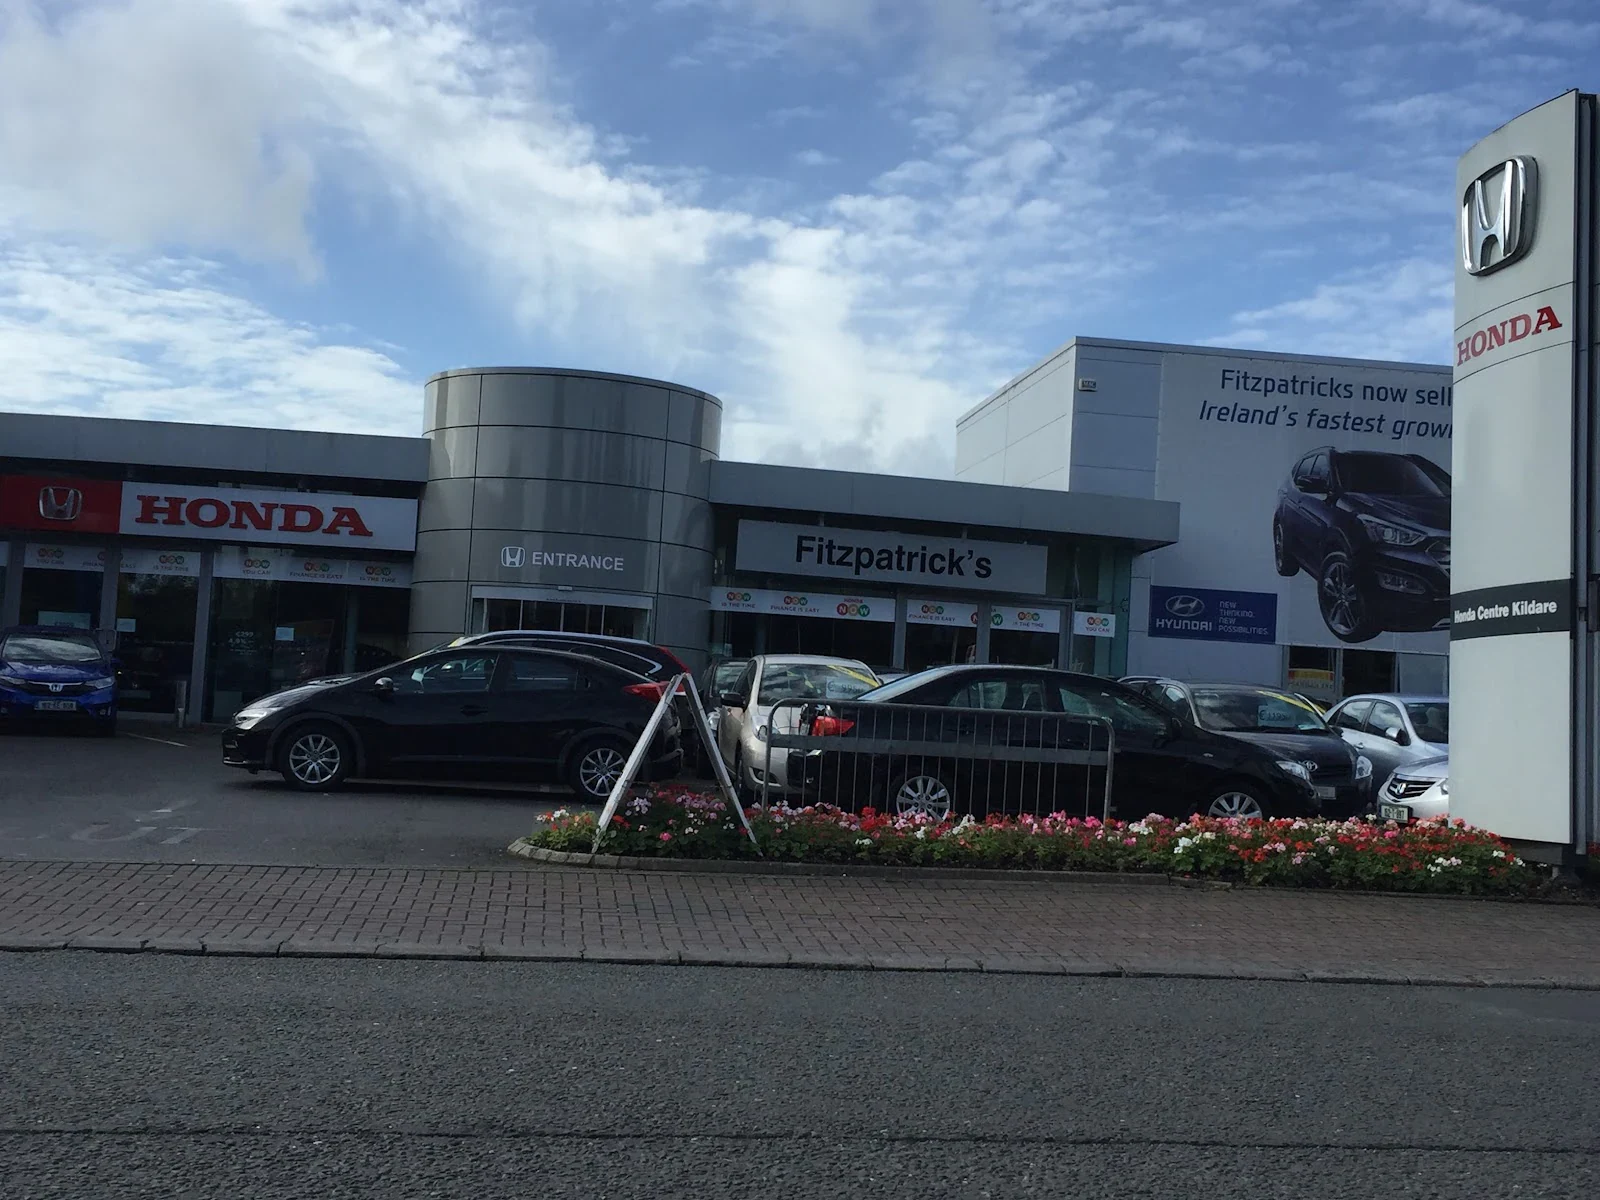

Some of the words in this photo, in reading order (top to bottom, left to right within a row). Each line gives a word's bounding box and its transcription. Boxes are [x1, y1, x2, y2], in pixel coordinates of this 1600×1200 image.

[1457, 305, 1563, 367] HONDA
[1220, 368, 1354, 400] Fitzpatricks
[1362, 384, 1409, 404] now
[1415, 386, 1452, 407] sell
[1199, 400, 1297, 427] Ireland's
[1306, 408, 1384, 434] fastest
[135, 494, 373, 537] HONDA
[531, 551, 624, 571] ENTRANCE
[795, 534, 992, 578] Fitzpatrick's
[244, 558, 271, 568] NOW
[304, 561, 330, 571] NOW
[365, 565, 391, 576] NOW
[727, 591, 752, 601] NOW
[783, 595, 809, 605] NOW
[836, 602, 871, 617] NOW
[921, 604, 945, 614] NOW
[1219, 600, 1238, 609] NEW
[1017, 611, 1041, 621] NOW
[1454, 608, 1476, 624] Honda
[1477, 604, 1510, 621] Centre
[1511, 600, 1558, 617] Kildare
[1086, 616, 1110, 626] NOW
[1155, 618, 1213, 632] HYUNDAI
[1218, 616, 1236, 625] NEW
